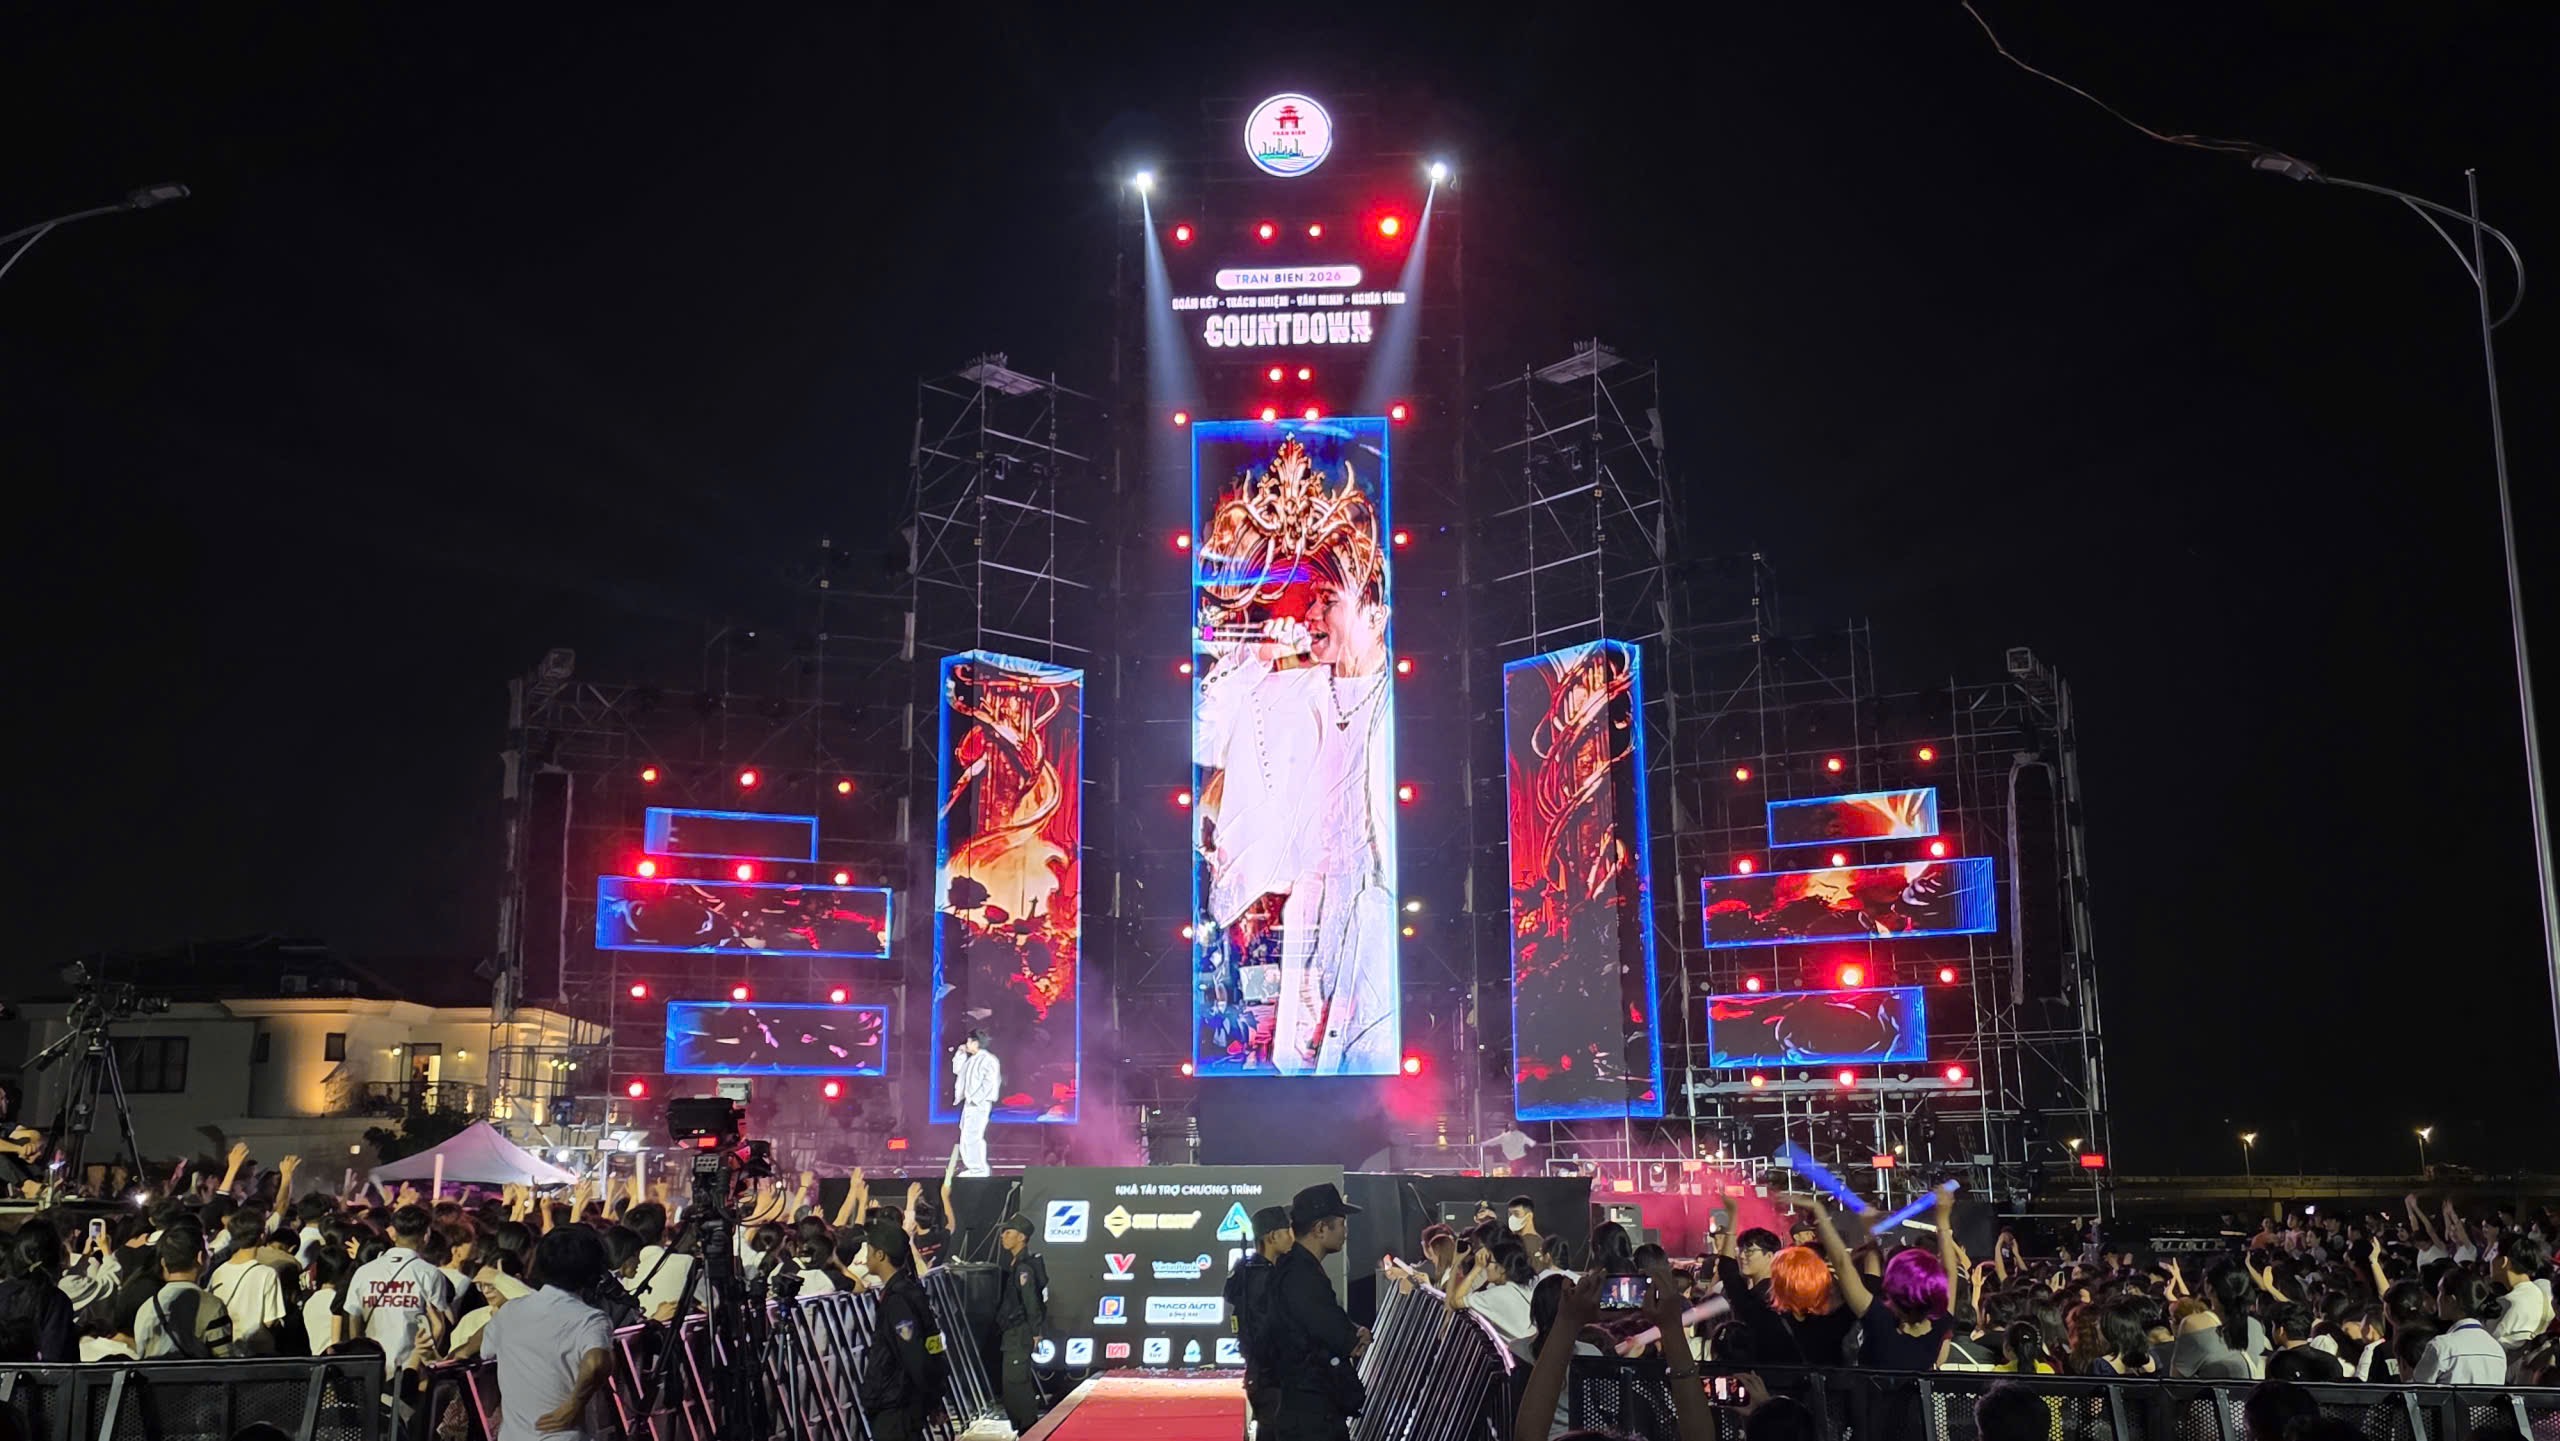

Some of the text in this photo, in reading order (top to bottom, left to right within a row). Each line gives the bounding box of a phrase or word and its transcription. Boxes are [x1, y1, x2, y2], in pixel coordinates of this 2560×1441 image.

[1309, 271, 1341, 282] 2026
[1203, 311, 1373, 348] COUNTDOWN
[369, 1281, 415, 1294] TOMMY
[362, 1295, 419, 1308] HILFIGER
